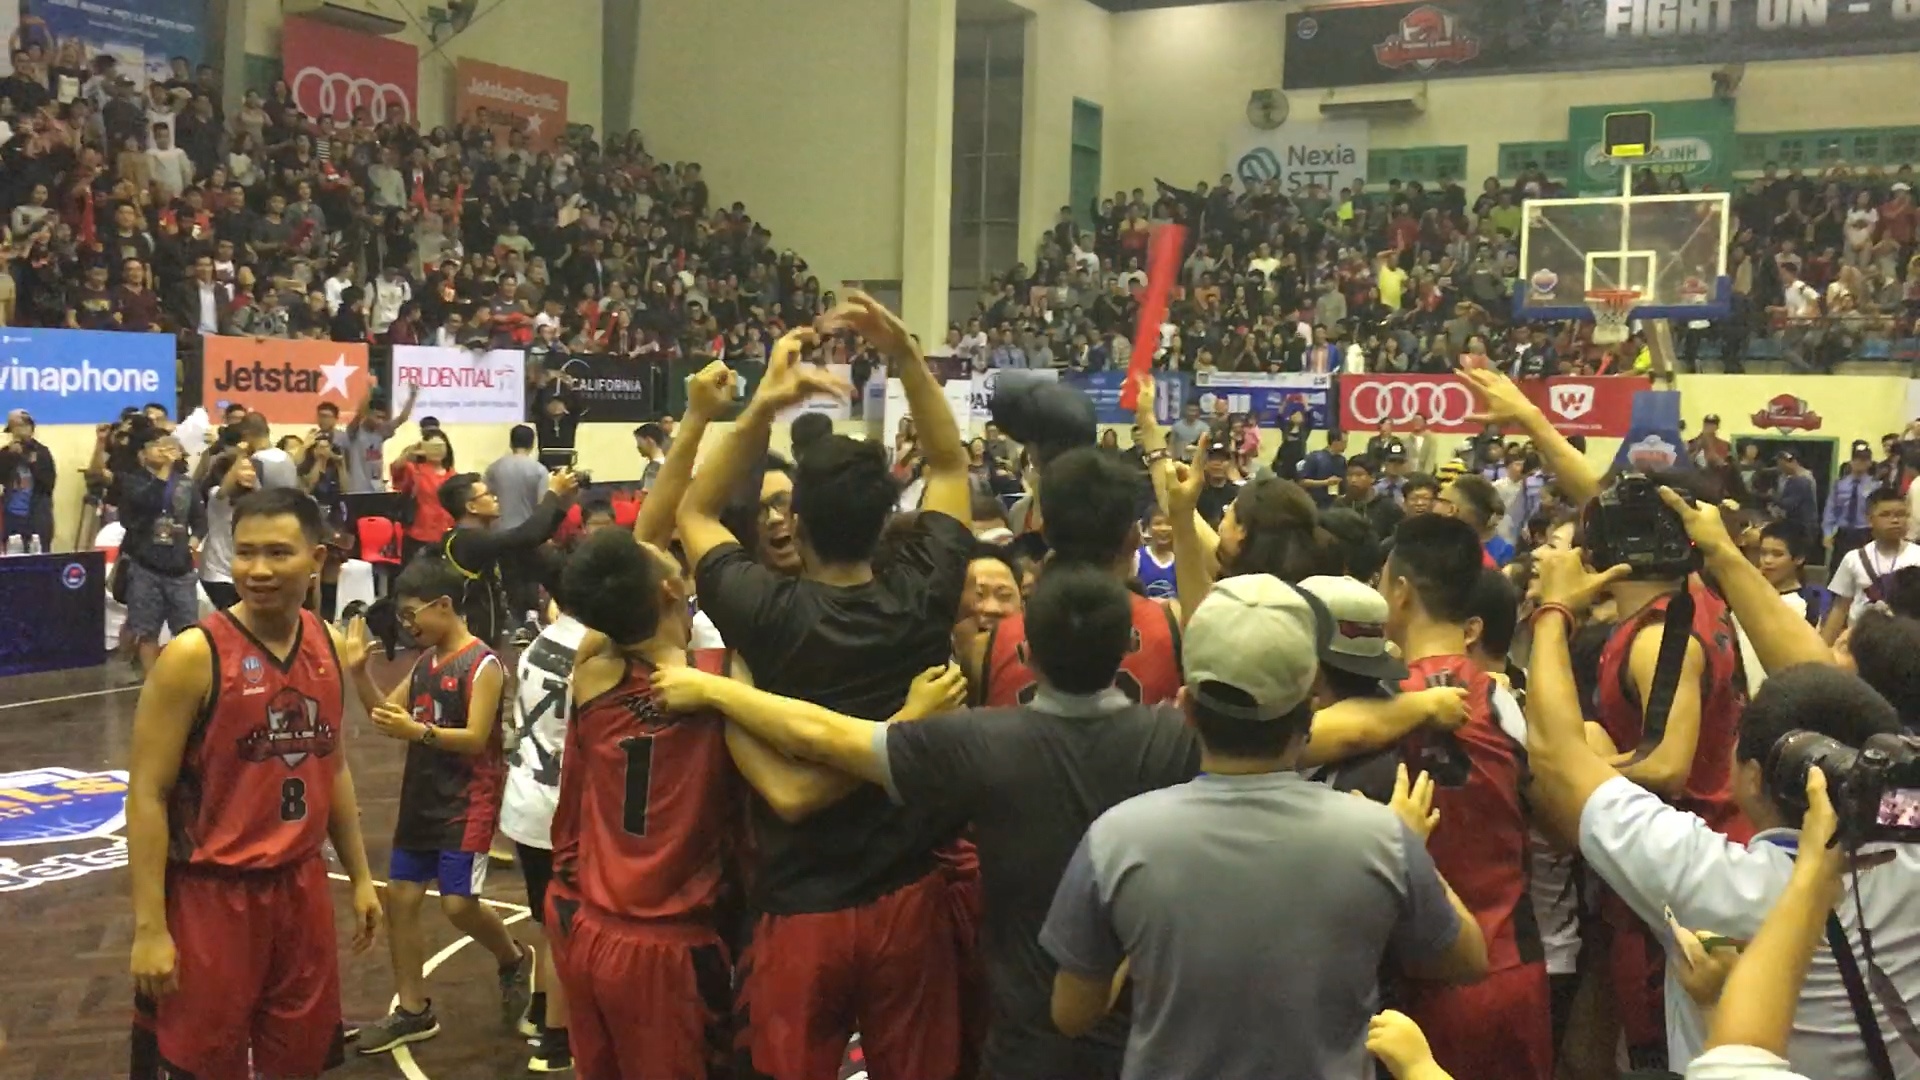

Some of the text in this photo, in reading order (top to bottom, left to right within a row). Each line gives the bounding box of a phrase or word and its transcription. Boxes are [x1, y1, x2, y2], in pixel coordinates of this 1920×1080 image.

[1604, 0, 1732, 38] FIGHT
[1286, 143, 1356, 167] Nexia
[214, 359, 323, 394] Jetstar
[397, 365, 495, 388] PRUDENTIAL
[280, 776, 308, 823] 8
[616, 734, 655, 838] 1
